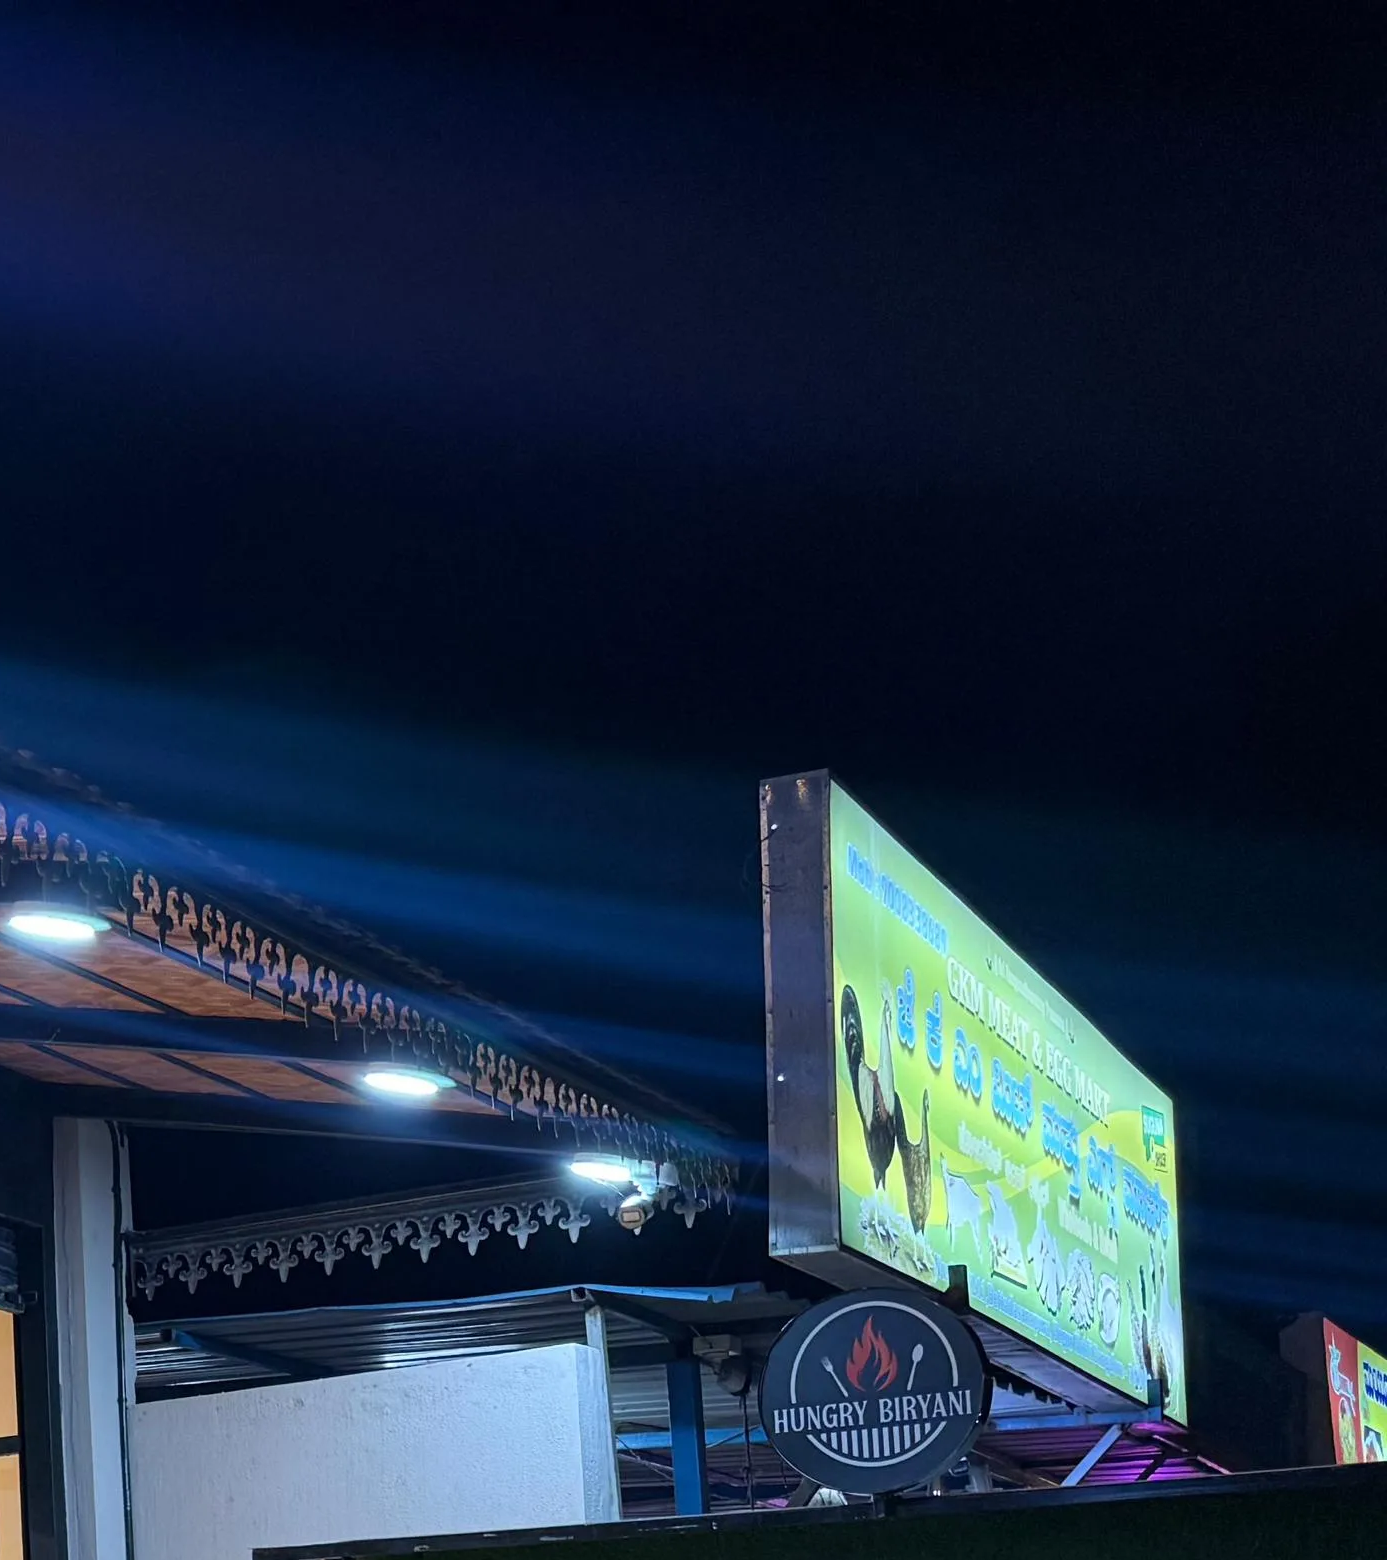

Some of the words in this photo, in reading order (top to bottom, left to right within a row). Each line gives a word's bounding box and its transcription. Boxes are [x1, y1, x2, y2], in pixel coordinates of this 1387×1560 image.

[947, 957, 985, 1017] GKM
[988, 989, 1029, 1058] MEAT
[1031, 1030, 1043, 1073] &
[1046, 1041, 1071, 1096] EGG
[1074, 1065, 1110, 1126] MART
[773, 1400, 868, 1434] HUNGRY
[879, 1389, 973, 1424] BIRYANI
